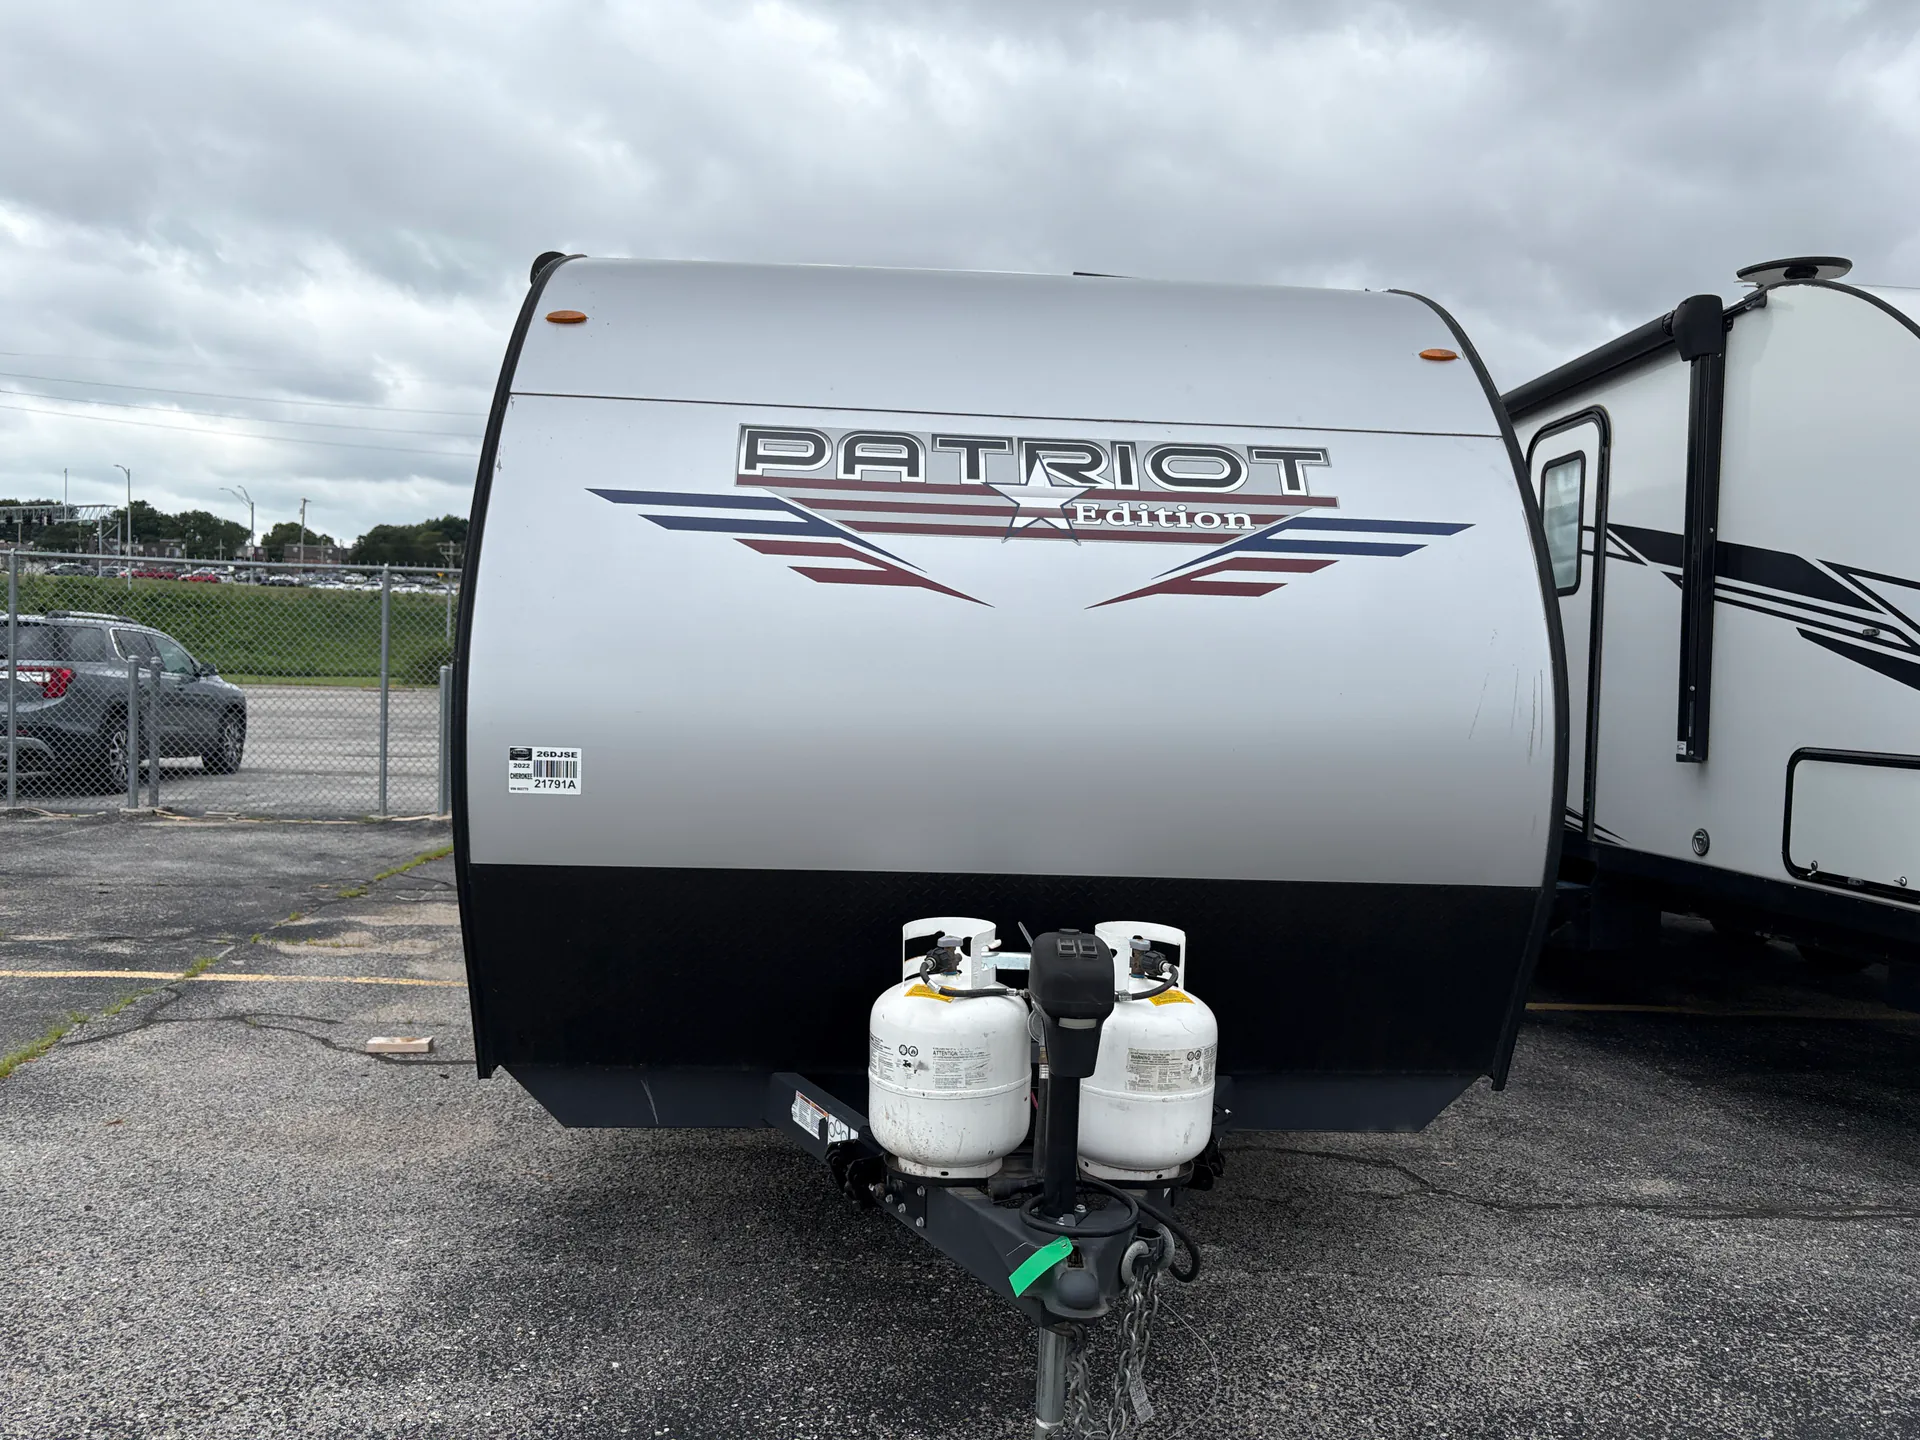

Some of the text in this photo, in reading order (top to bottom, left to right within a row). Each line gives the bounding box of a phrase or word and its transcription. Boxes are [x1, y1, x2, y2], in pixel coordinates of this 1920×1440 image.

[738, 424, 1332, 497] PATRIOT
[1071, 502, 1257, 530] Edition
[536, 751, 578, 759] 26DJSE
[534, 779, 576, 789] 21791A
